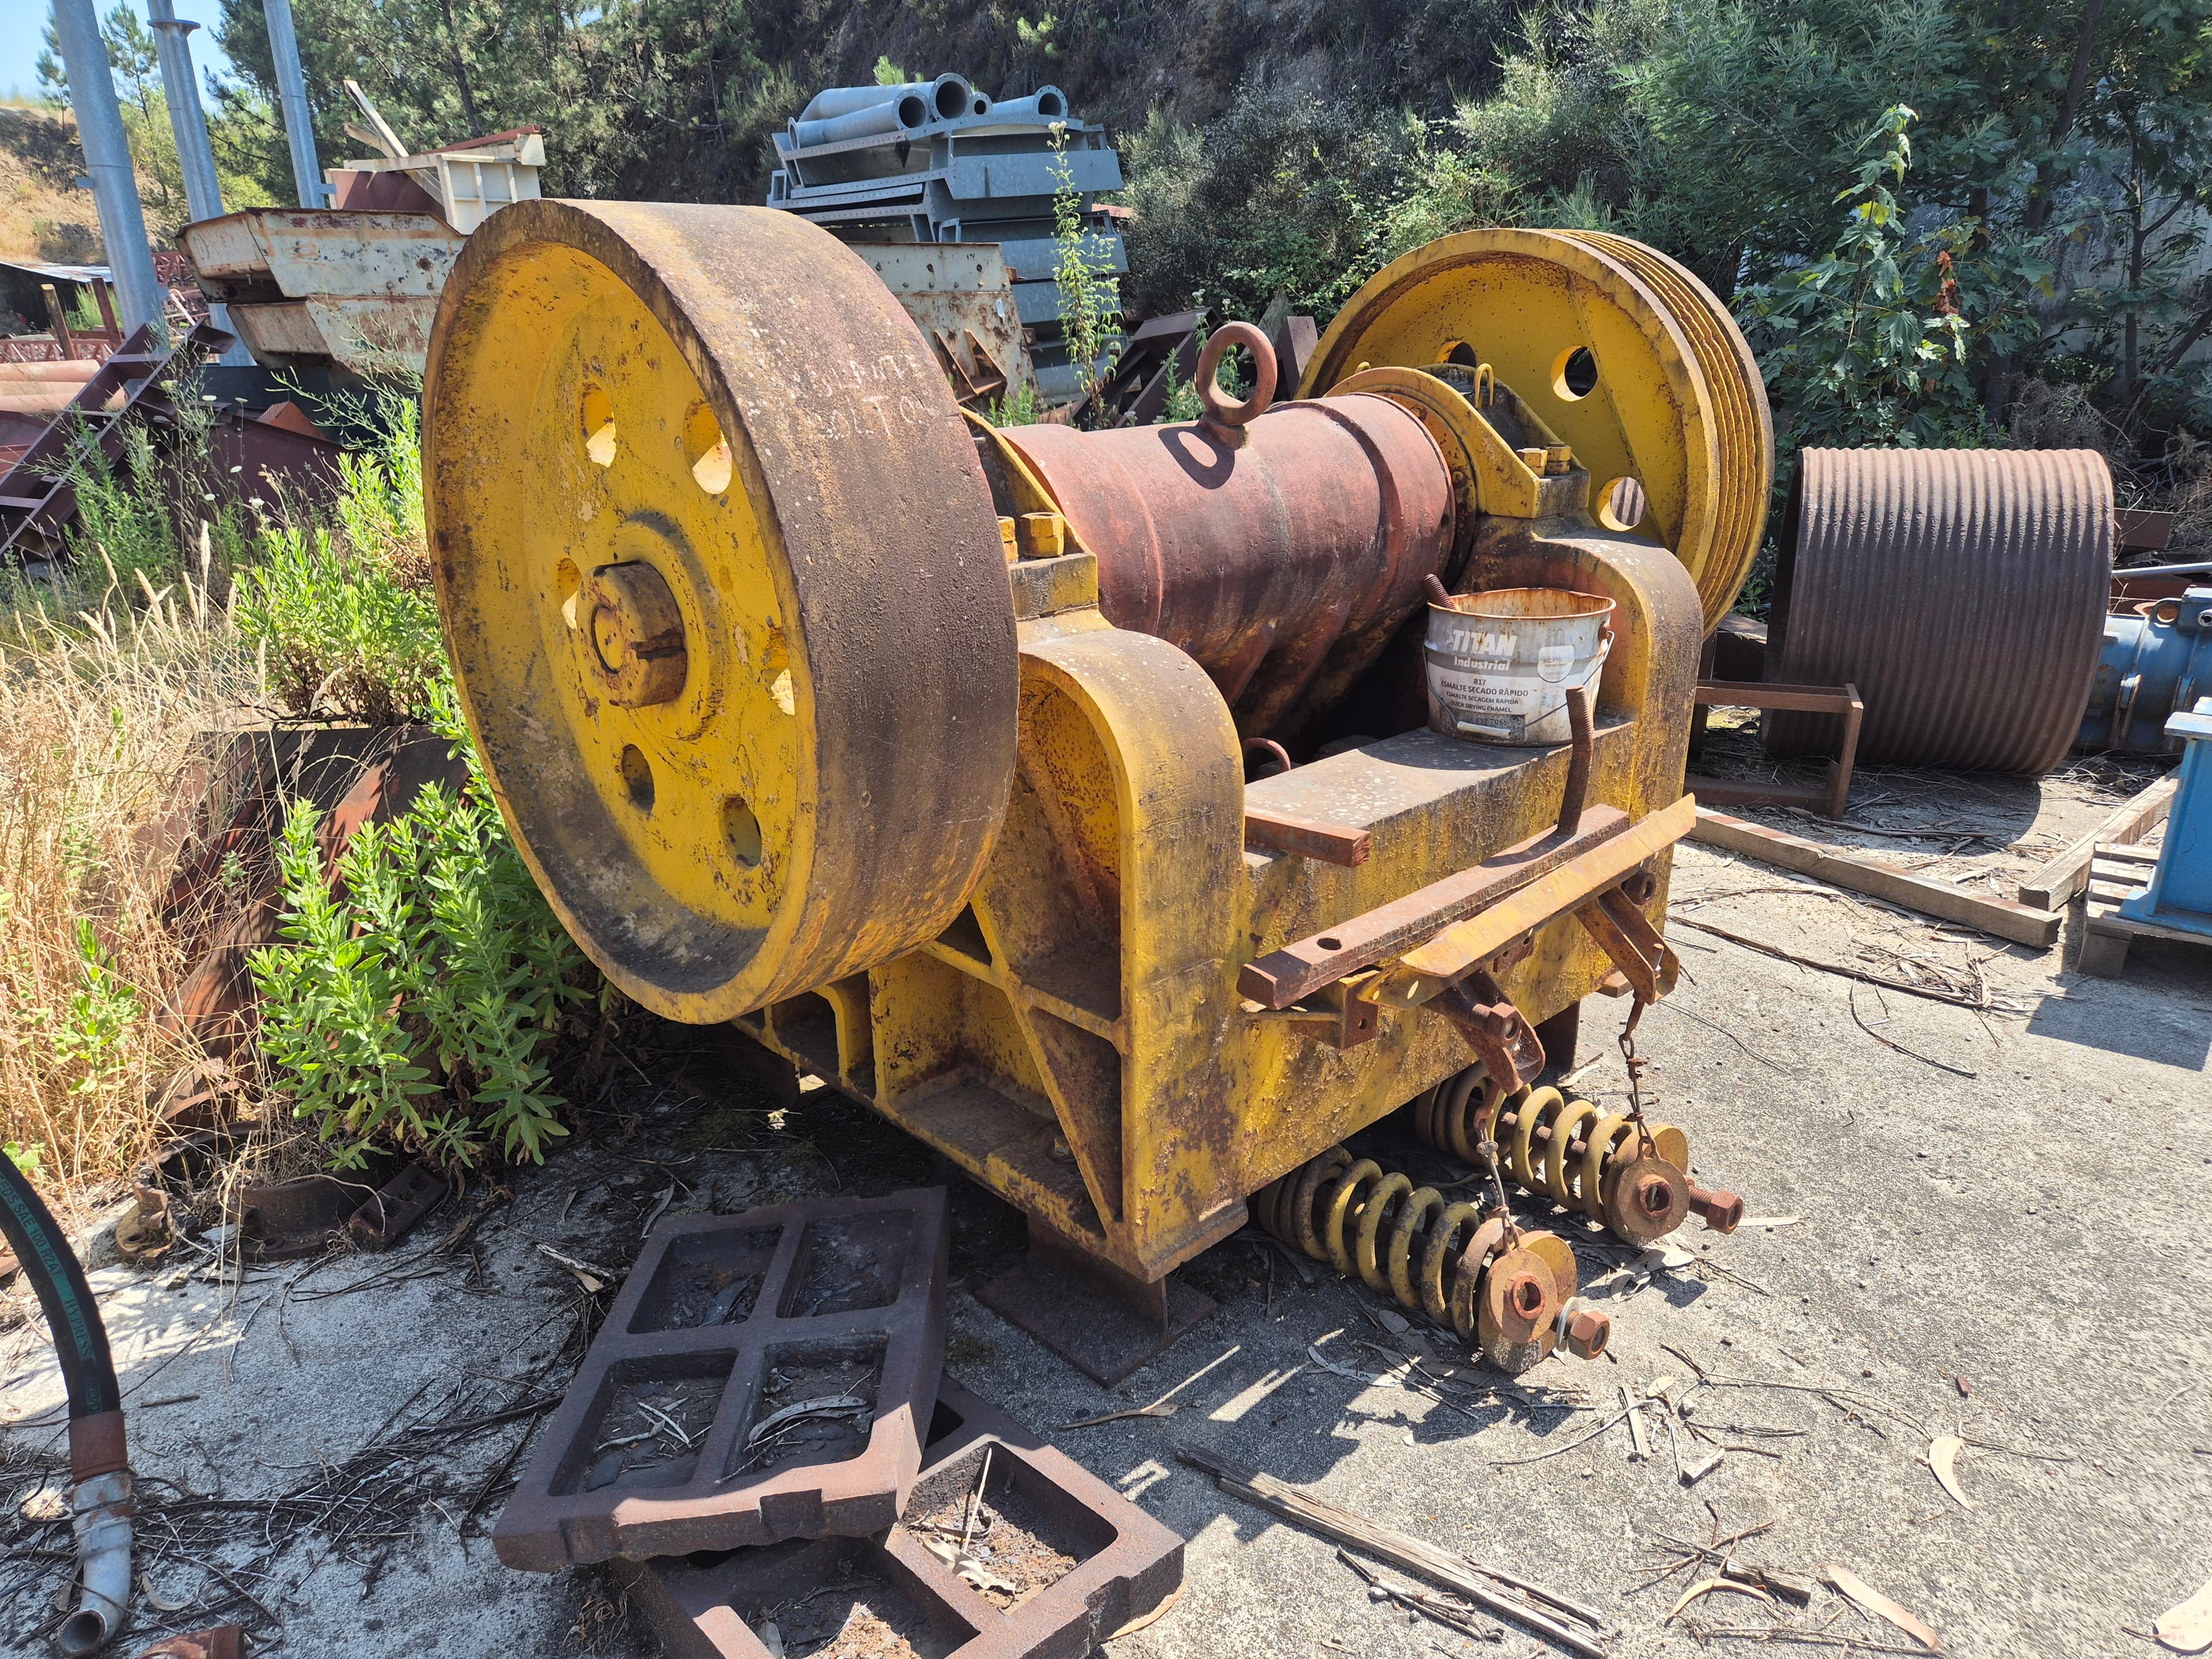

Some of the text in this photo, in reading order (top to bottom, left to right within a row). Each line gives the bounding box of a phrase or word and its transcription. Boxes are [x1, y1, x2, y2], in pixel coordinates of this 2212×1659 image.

[1452, 630, 1517, 656] TITAN
[1454, 656, 1511, 671] Industrial
[1441, 680, 1529, 696] ESMALTE SECADO RÁPIDO
[1446, 691, 1467, 700] ESMALTE
[14, 1203, 36, 1228] SAE
[29, 1227, 47, 1247] 100
[40, 1249, 63, 1276] R2AT
[64, 1299, 93, 1356] HYPRESS
